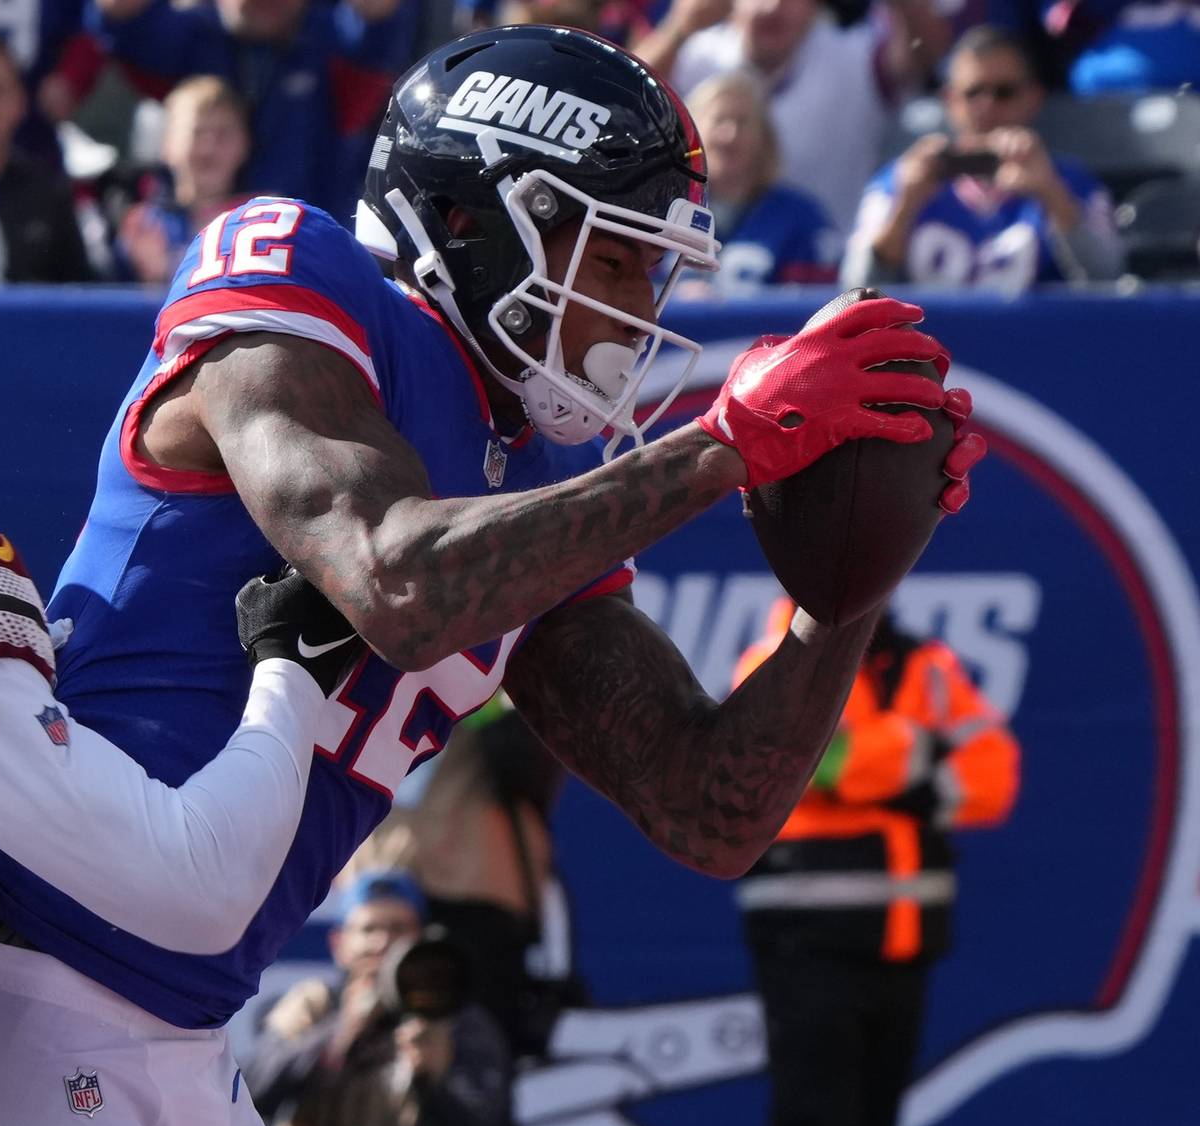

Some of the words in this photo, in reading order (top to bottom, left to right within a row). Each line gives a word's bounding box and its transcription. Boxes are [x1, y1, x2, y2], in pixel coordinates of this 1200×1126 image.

[446, 70, 611, 149] GIANTS
[186, 201, 304, 290] 12
[73, 1089, 100, 1108] NFL
